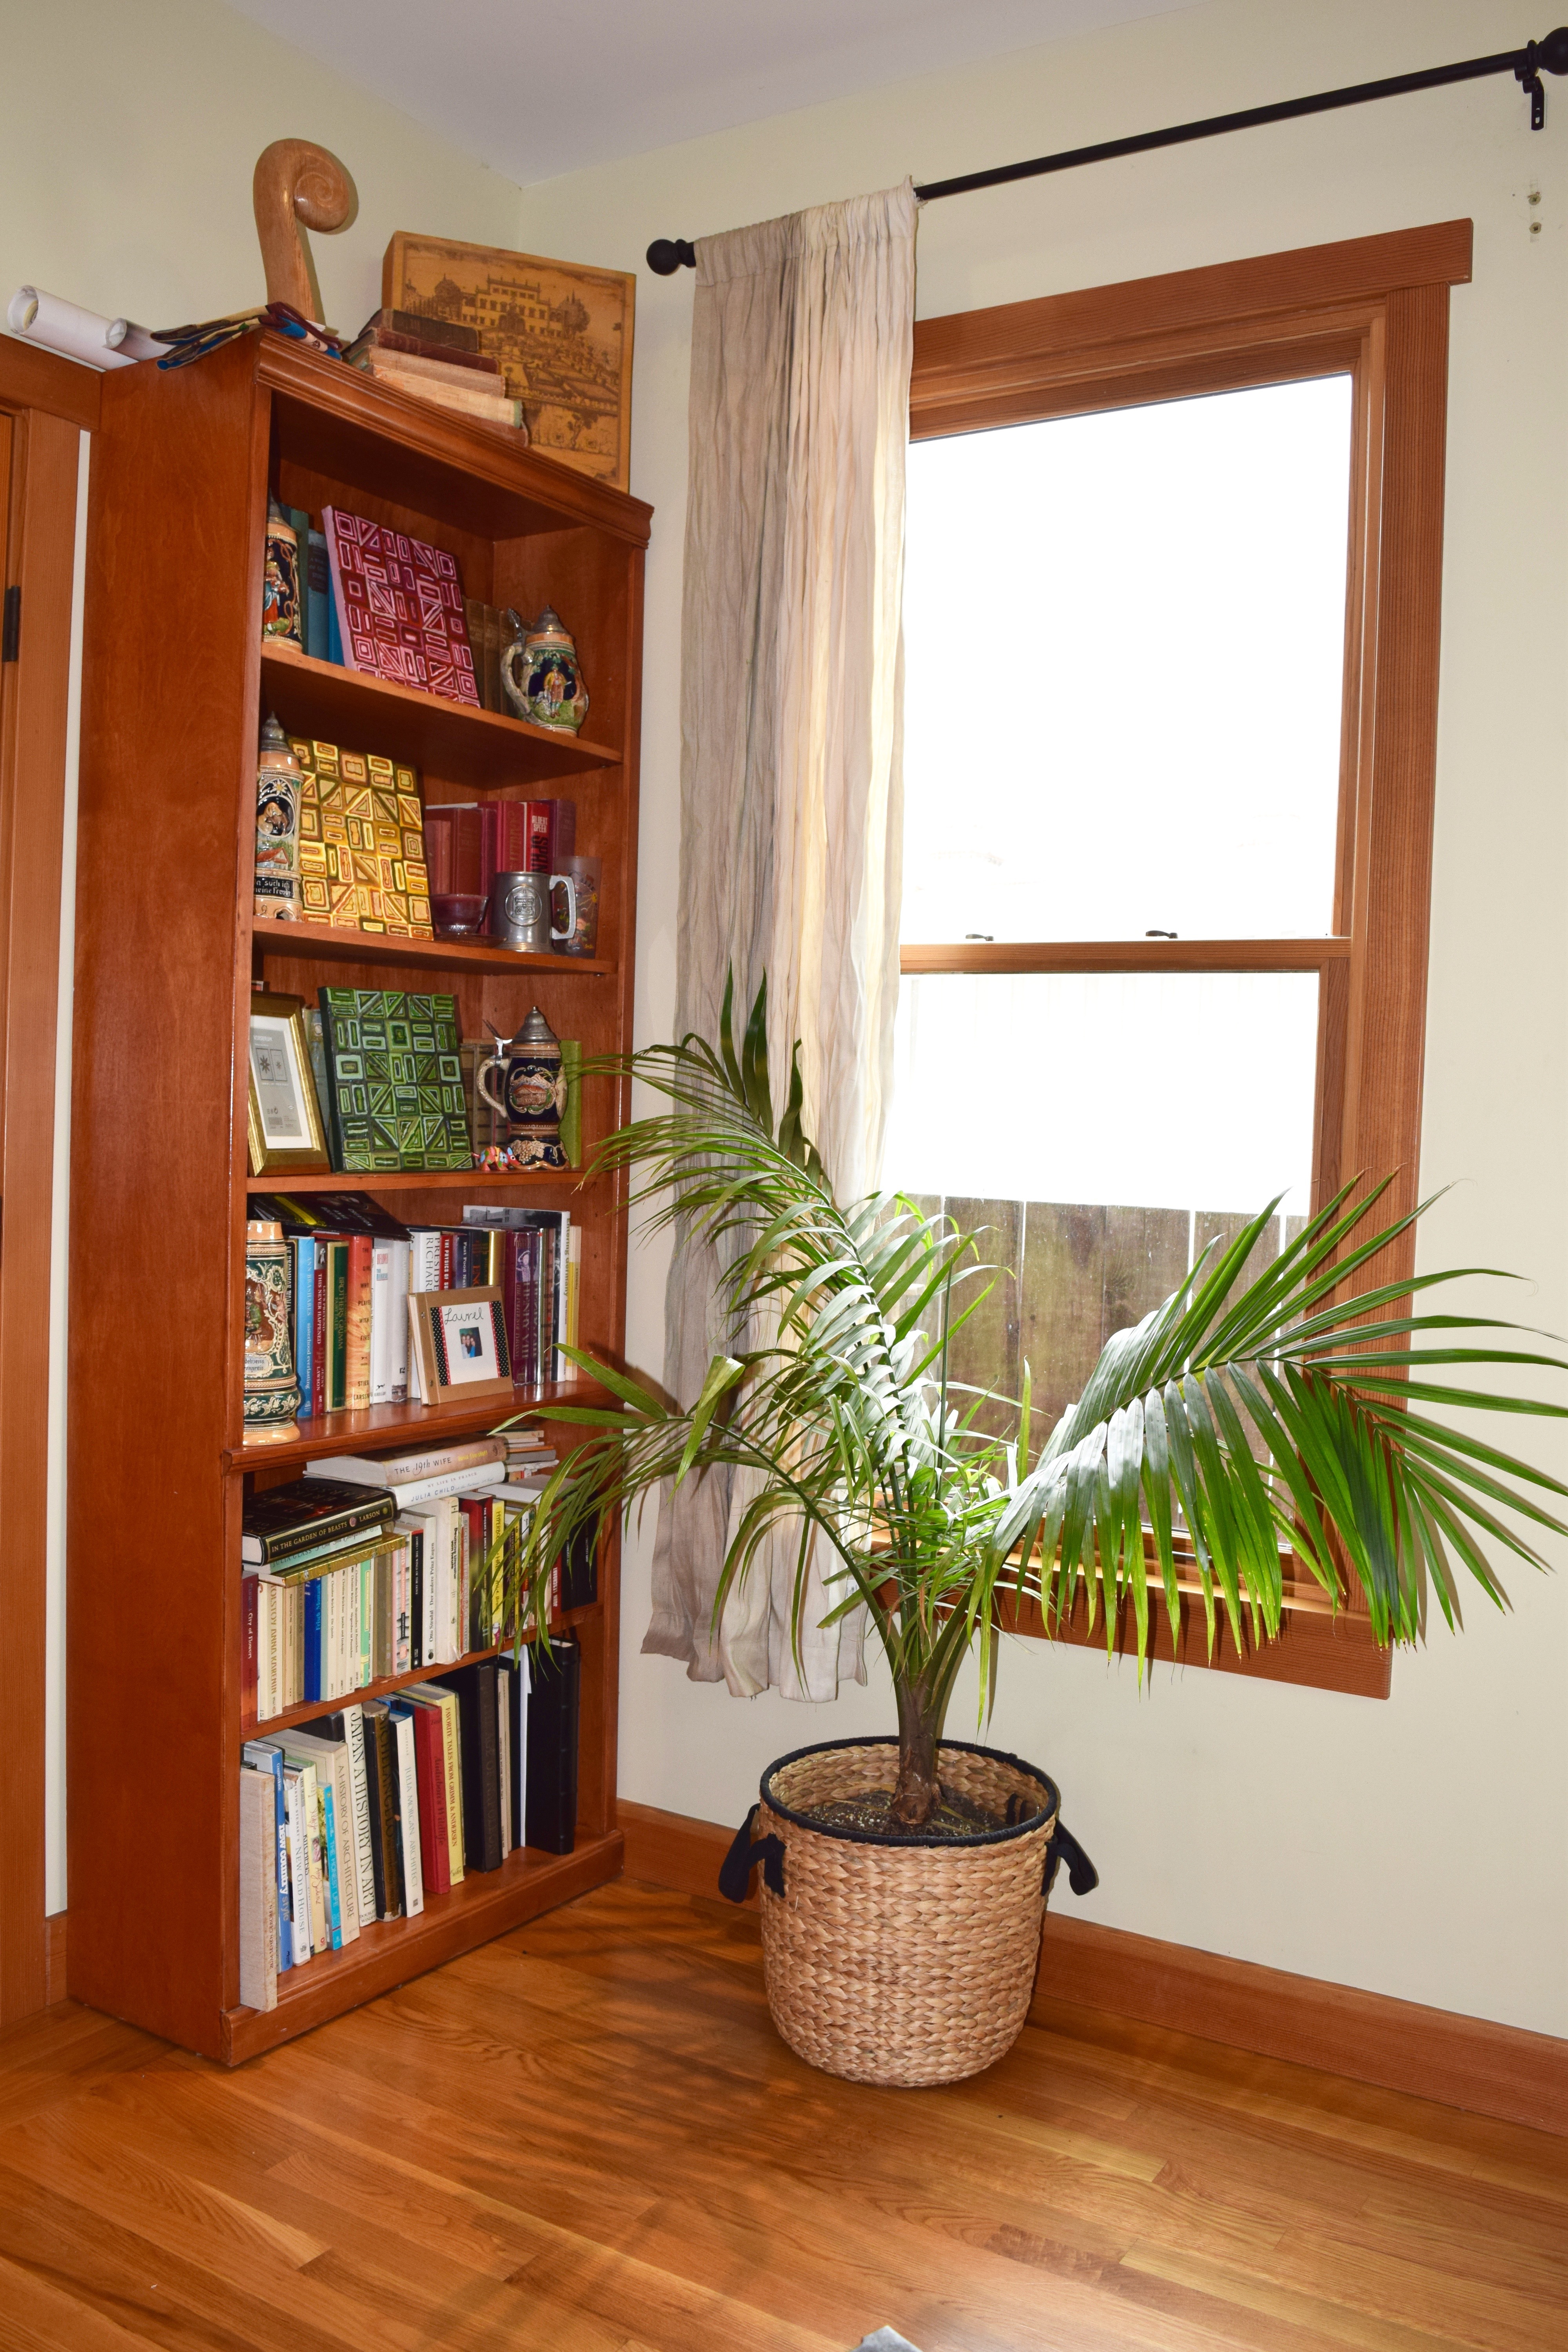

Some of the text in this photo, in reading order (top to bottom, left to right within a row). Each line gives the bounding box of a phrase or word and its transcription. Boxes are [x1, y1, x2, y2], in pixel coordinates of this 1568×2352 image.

[532, 815, 548, 825] ALBERT
[534, 824, 547, 833] SPEER
[444, 1307, 484, 1325] Laurel
[394, 1457, 452, 1476] THE 19th WIFE
[458, 1472, 478, 1480] FRANCE
[411, 1486, 455, 1502] JULIA CHILD
[359, 1510, 380, 1522] LARSON
[280, 1540, 292, 1549] THE
[294, 1533, 318, 1544] GARDEN
[328, 1521, 347, 1533] BEASTS
[273, 1548, 313, 1567] JULIA GLASS
[338, 1765, 344, 1773] A
[339, 1774, 348, 1819] HISTORY
[434, 1756, 446, 1846] Audubon's Wildlife
[350, 1712, 375, 1907] JAPAN A HISTORY IN ART
[341, 1821, 349, 1835] OF
[280, 1850, 288, 1894] country
[409, 1840, 418, 1887] ARCHITECT
[343, 1839, 355, 1920] ARCHITECTURE
